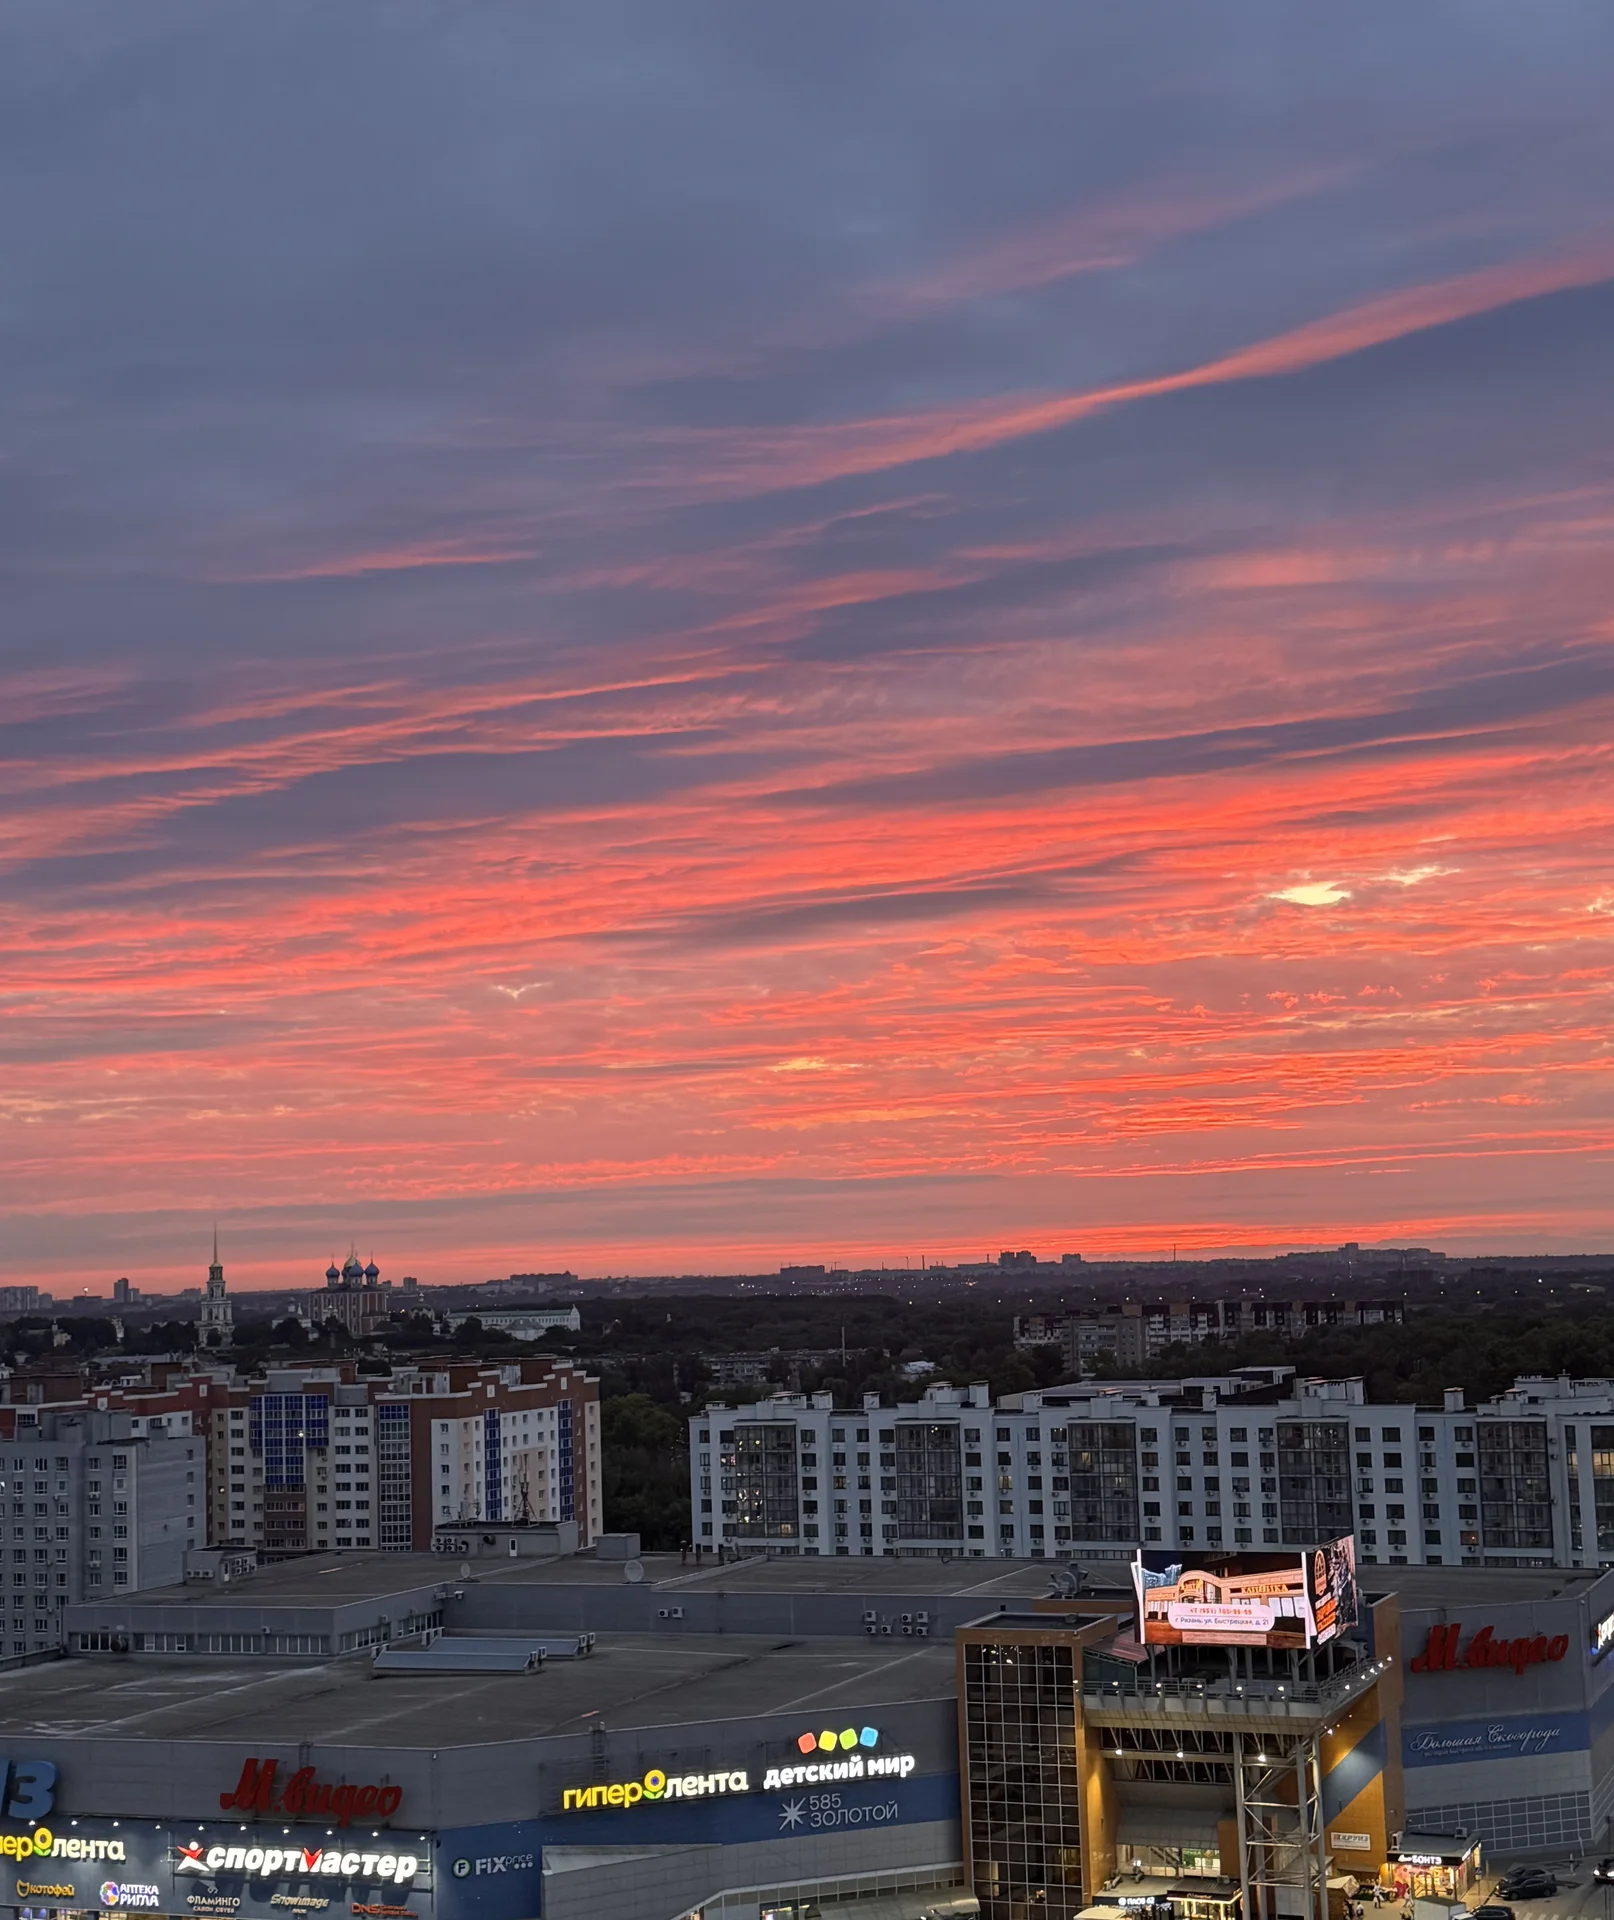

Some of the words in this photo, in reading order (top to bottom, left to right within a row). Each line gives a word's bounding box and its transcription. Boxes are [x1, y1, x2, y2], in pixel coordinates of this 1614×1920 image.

[1410, 1623, 1569, 1675] М.видео
[1410, 1731, 1482, 1751] Большая
[1488, 1724, 1560, 1751] Сковорода
[763, 1755, 864, 1790] детский
[867, 1755, 915, 1778] мир
[219, 1758, 402, 1828] М.видео
[809, 1793, 842, 1811] 585
[810, 1801, 898, 1828] ЗОЛОТОЙ
[120, 1883, 160, 1895] АПТЕКА
[120, 1894, 160, 1906] РИГЛА
[186, 1895, 241, 1907] ФЛАМИНГО
[351, 1902, 380, 1914] DNS
